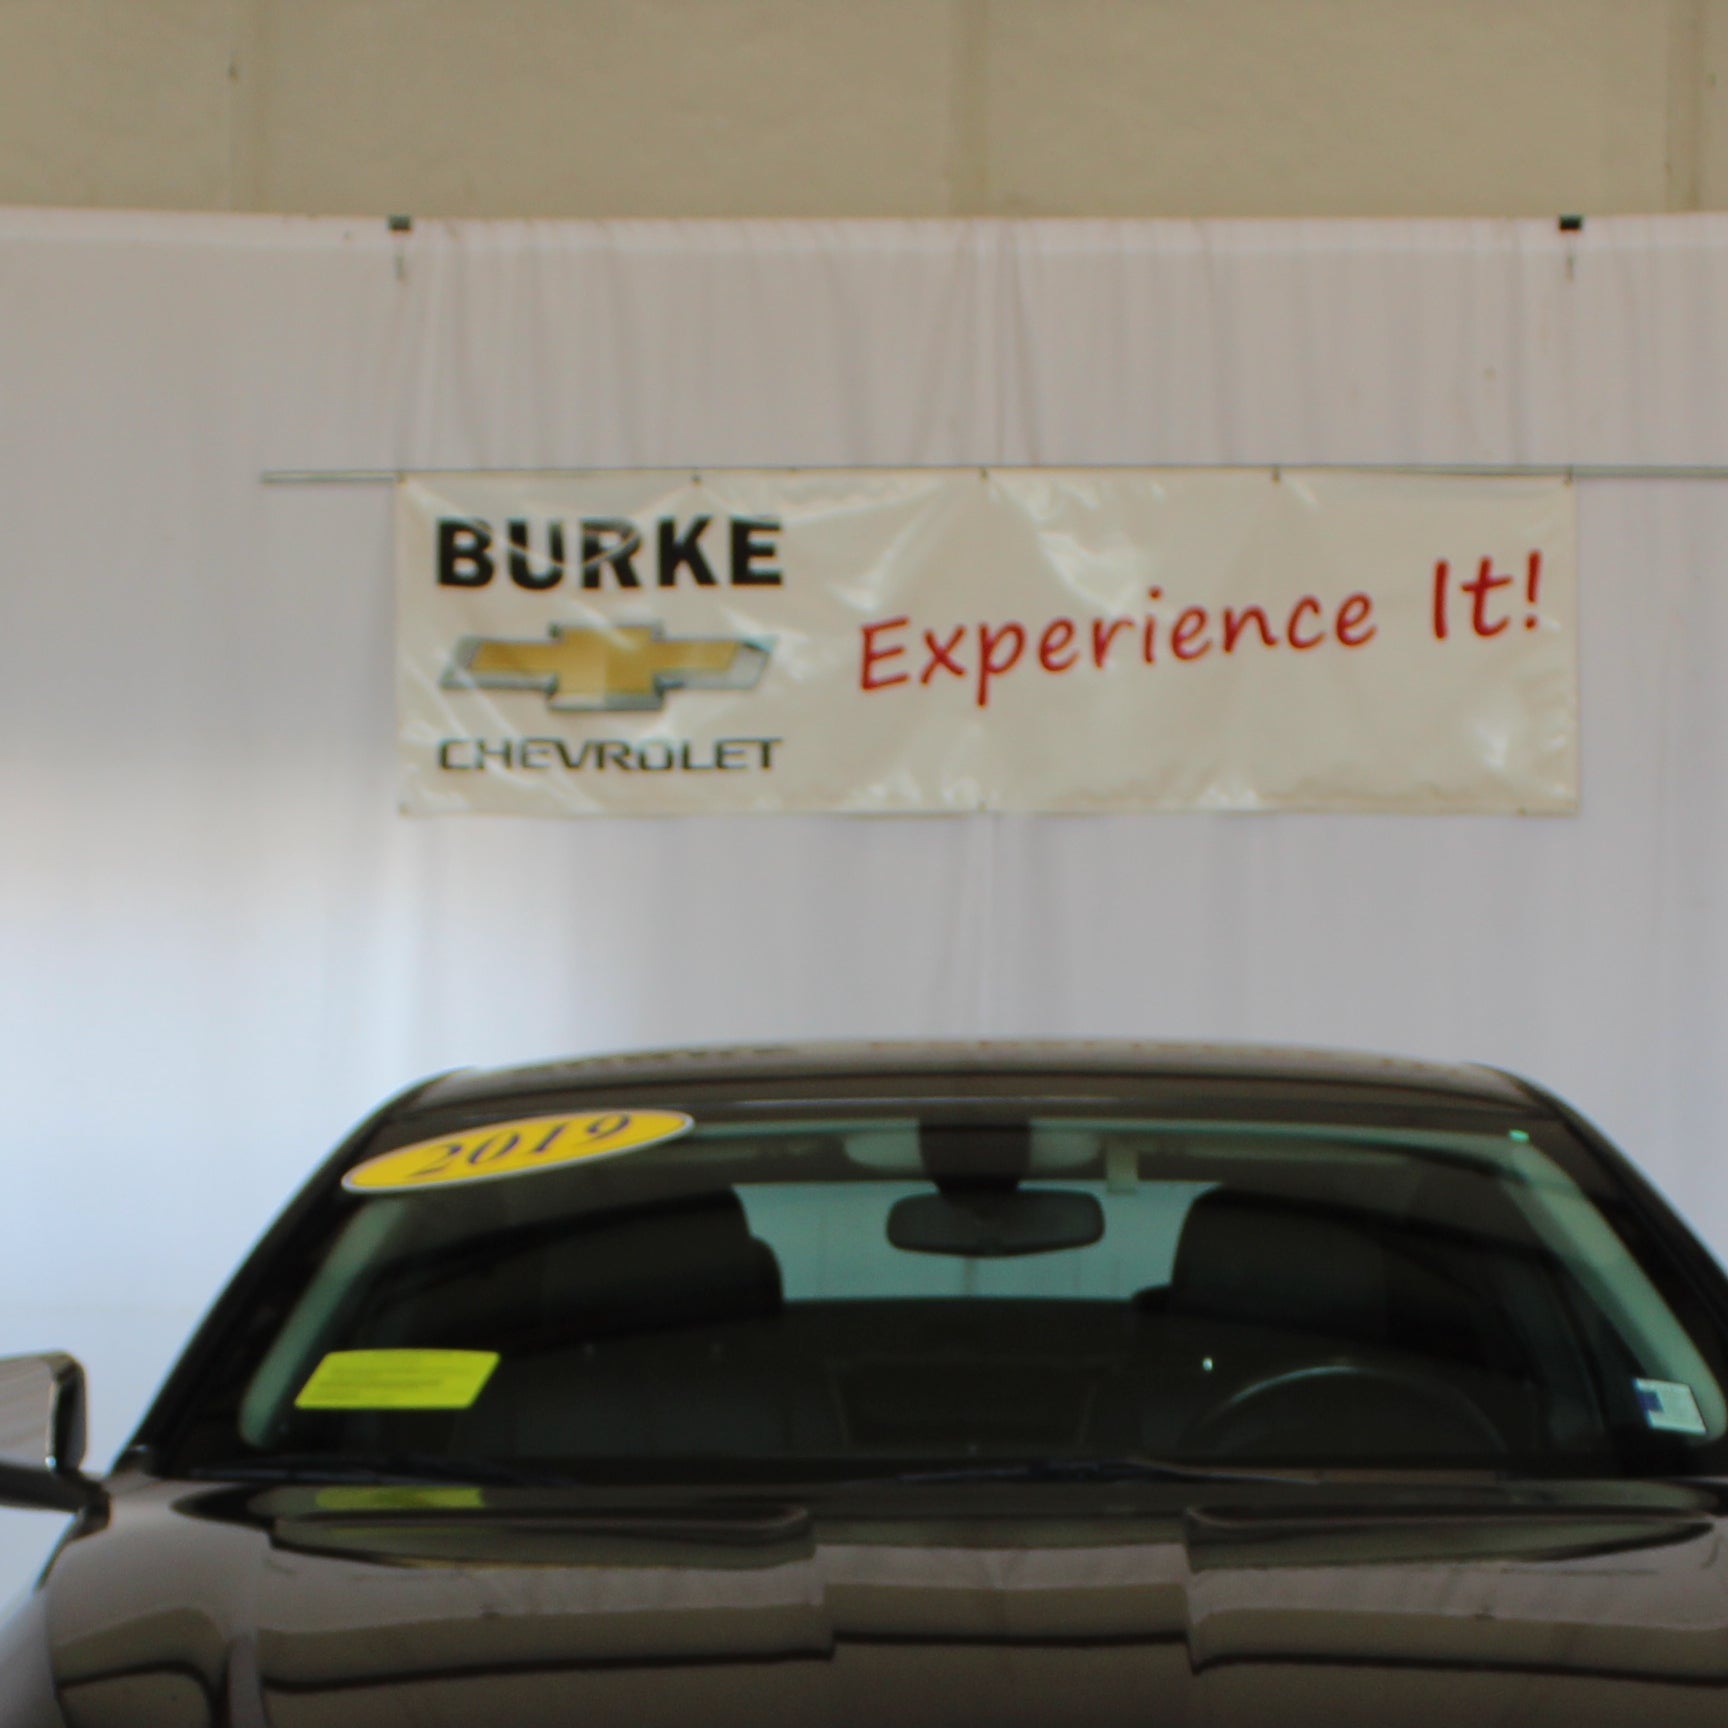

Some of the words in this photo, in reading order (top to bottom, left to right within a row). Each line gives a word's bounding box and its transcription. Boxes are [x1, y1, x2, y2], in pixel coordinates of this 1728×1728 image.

[436, 517, 783, 590] BURKE
[858, 587, 1379, 706] Experience
[1429, 550, 1545, 641] It!
[438, 738, 784, 771] CHEVROLET
[406, 1113, 633, 1178] 2019
